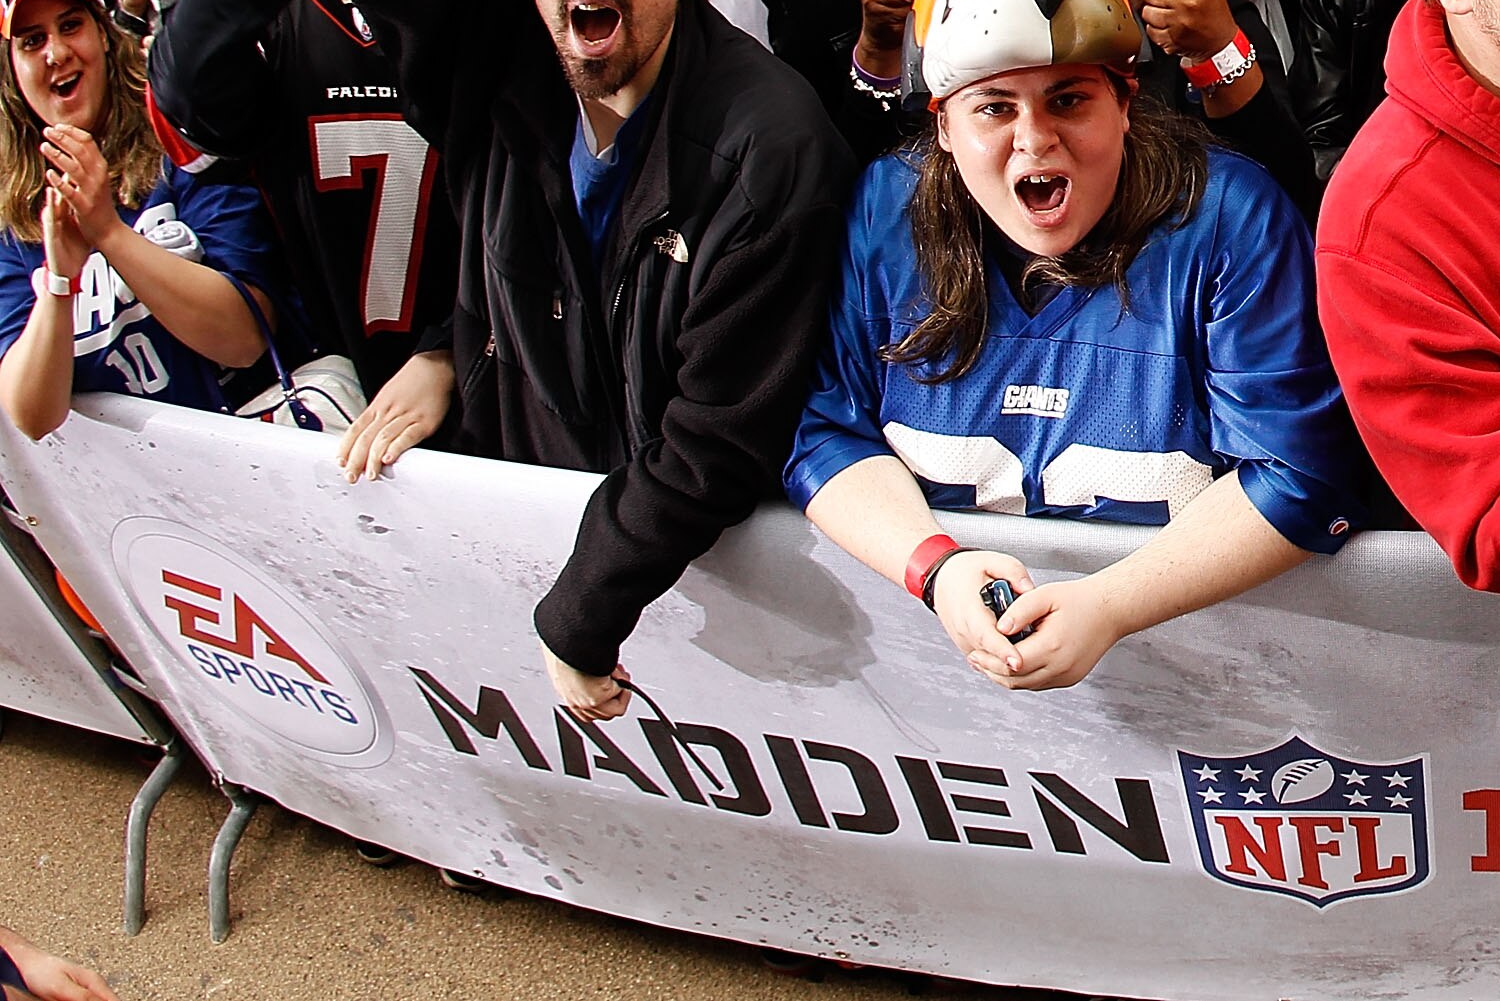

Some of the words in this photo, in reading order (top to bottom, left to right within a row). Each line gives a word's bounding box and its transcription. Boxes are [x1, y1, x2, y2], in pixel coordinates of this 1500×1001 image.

[308, 112, 439, 333] 7
[105, 332, 171, 395] 10
[1003, 384, 1070, 412] GIANTS
[162, 569, 334, 687] EA
[187, 643, 359, 725] SPORTS
[408, 665, 1171, 865] MADDEN
[1214, 815, 1408, 891] NFL
